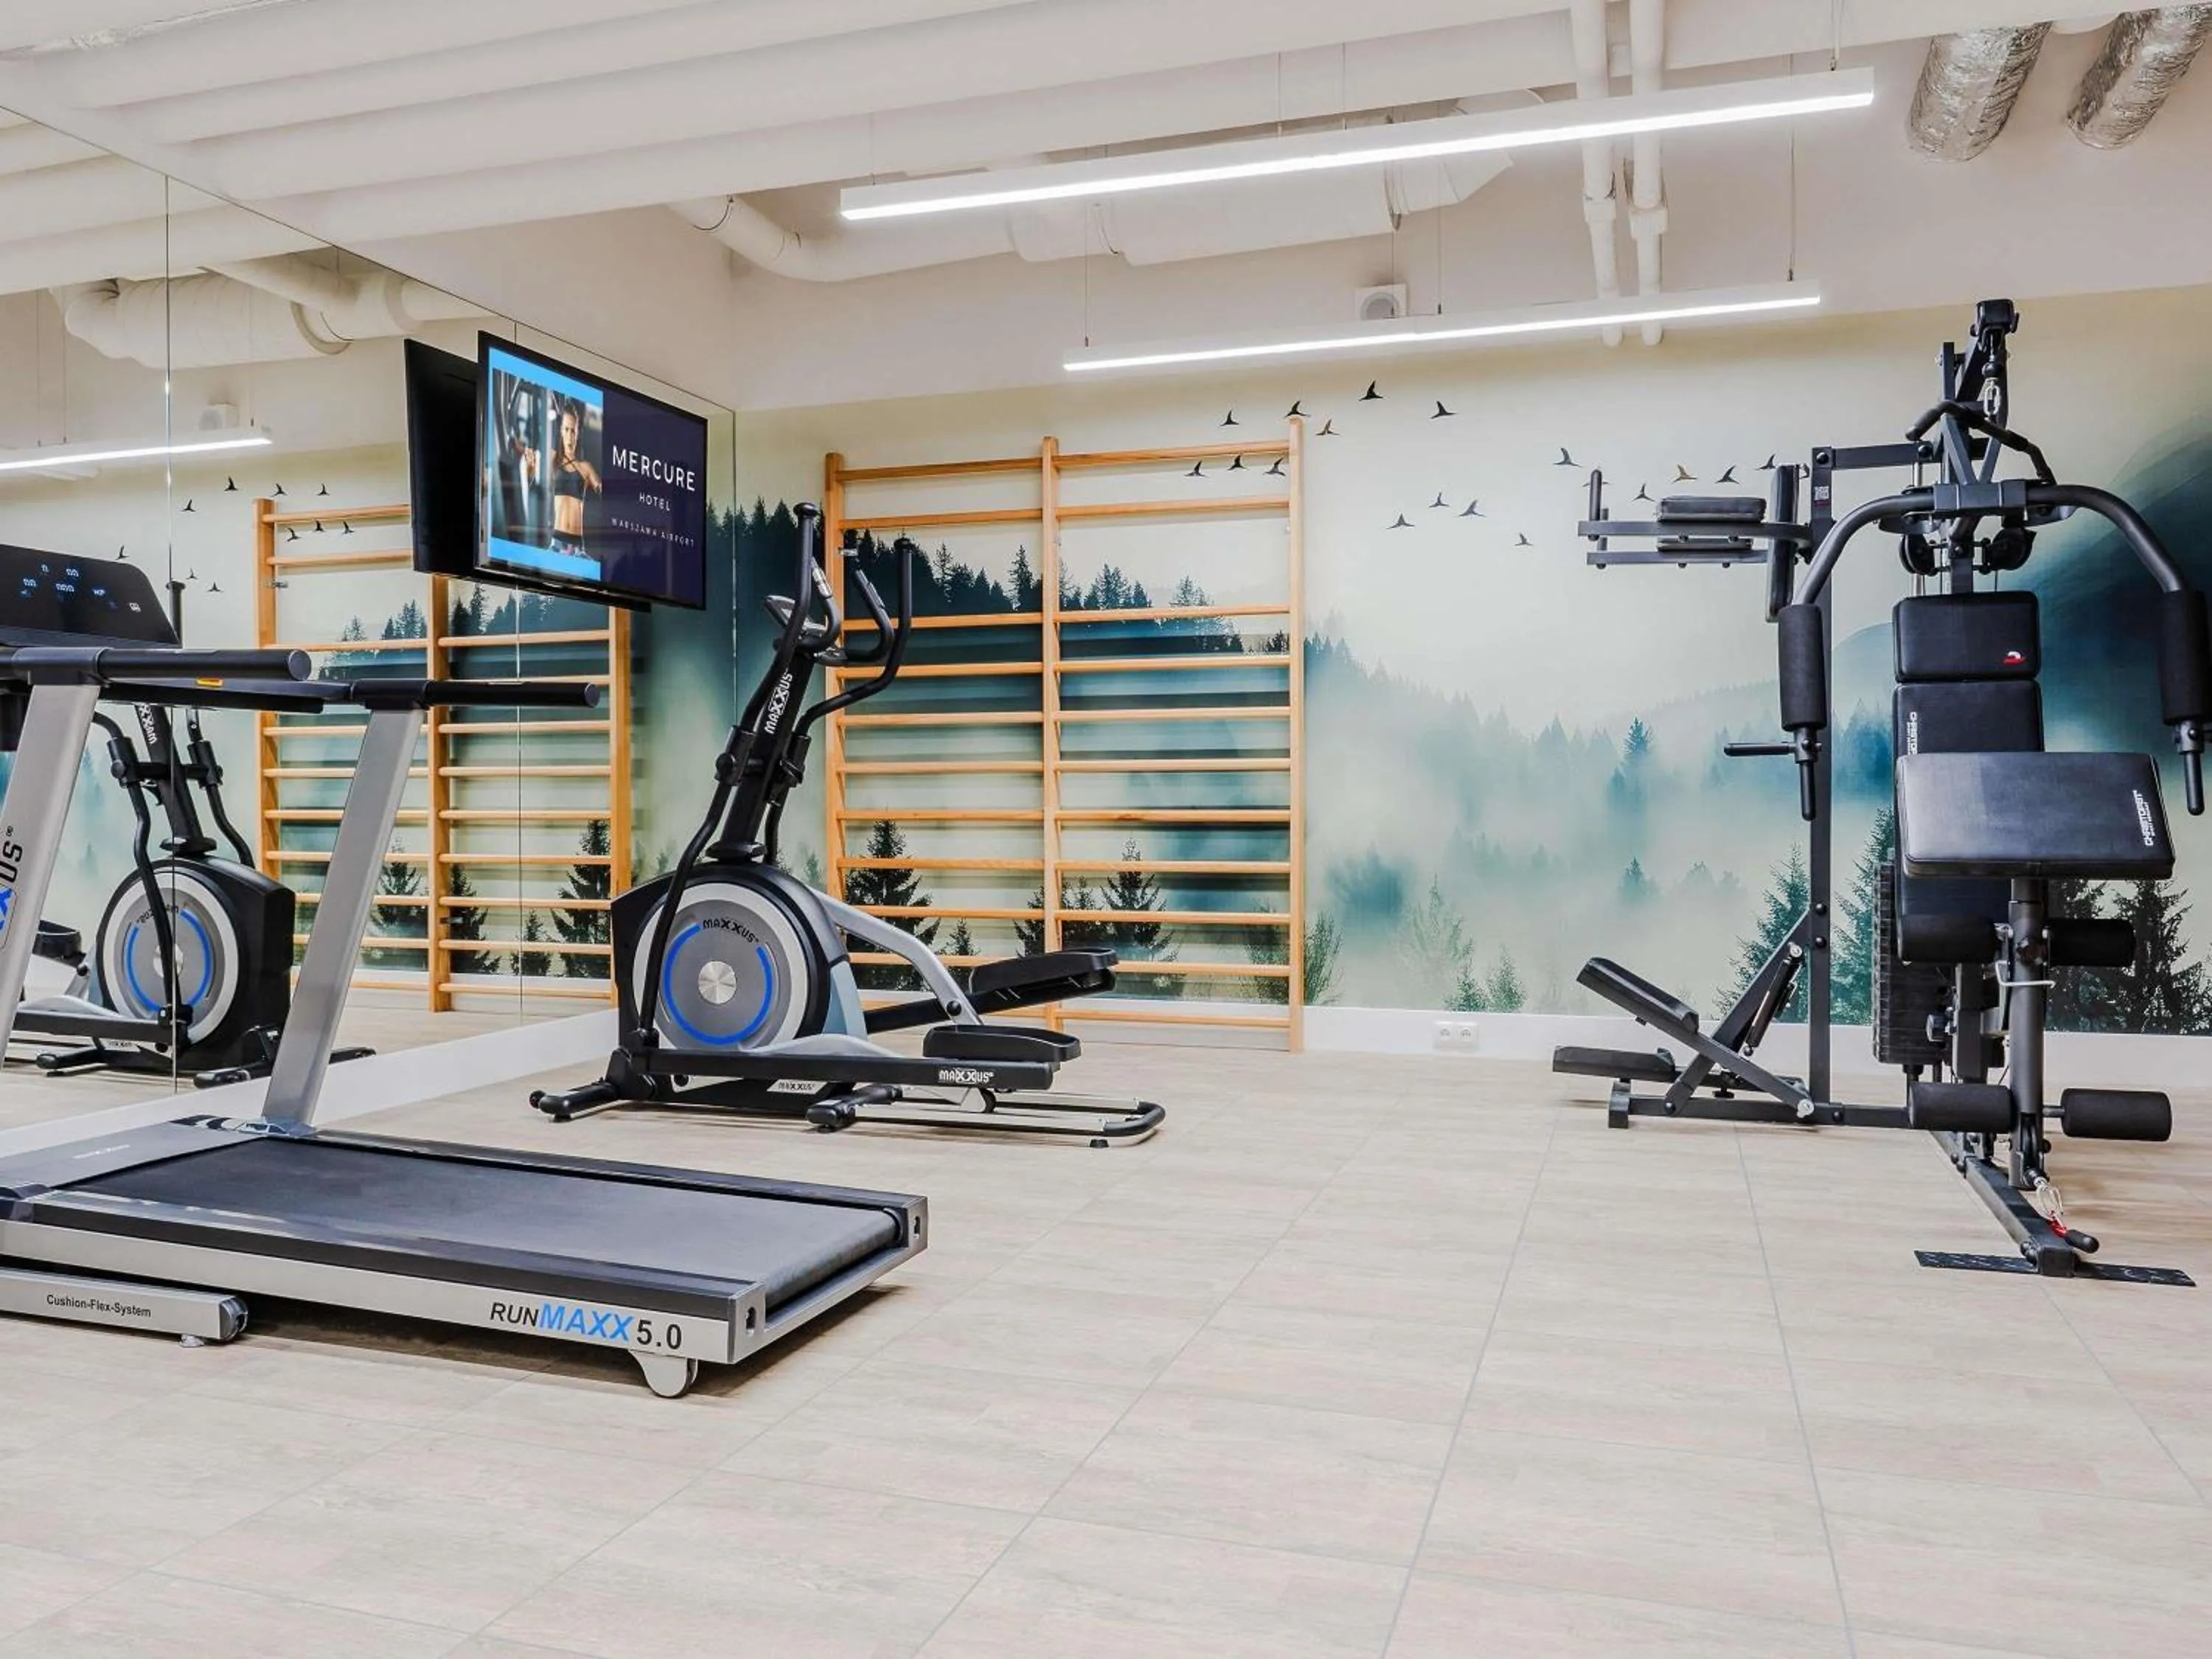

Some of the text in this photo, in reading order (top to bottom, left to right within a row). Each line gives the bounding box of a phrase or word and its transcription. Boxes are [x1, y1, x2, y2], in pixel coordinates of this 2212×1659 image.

[613, 445, 695, 492] MERCURE
[639, 492, 670, 511] HOTEL
[764, 671, 793, 734] MAXXUS
[703, 918, 757, 943] MAXXUS
[939, 1067, 990, 1085] MAXXUS
[46, 1294, 152, 1317] Cushion-Flex-System
[636, 1319, 683, 1350] 5.0
